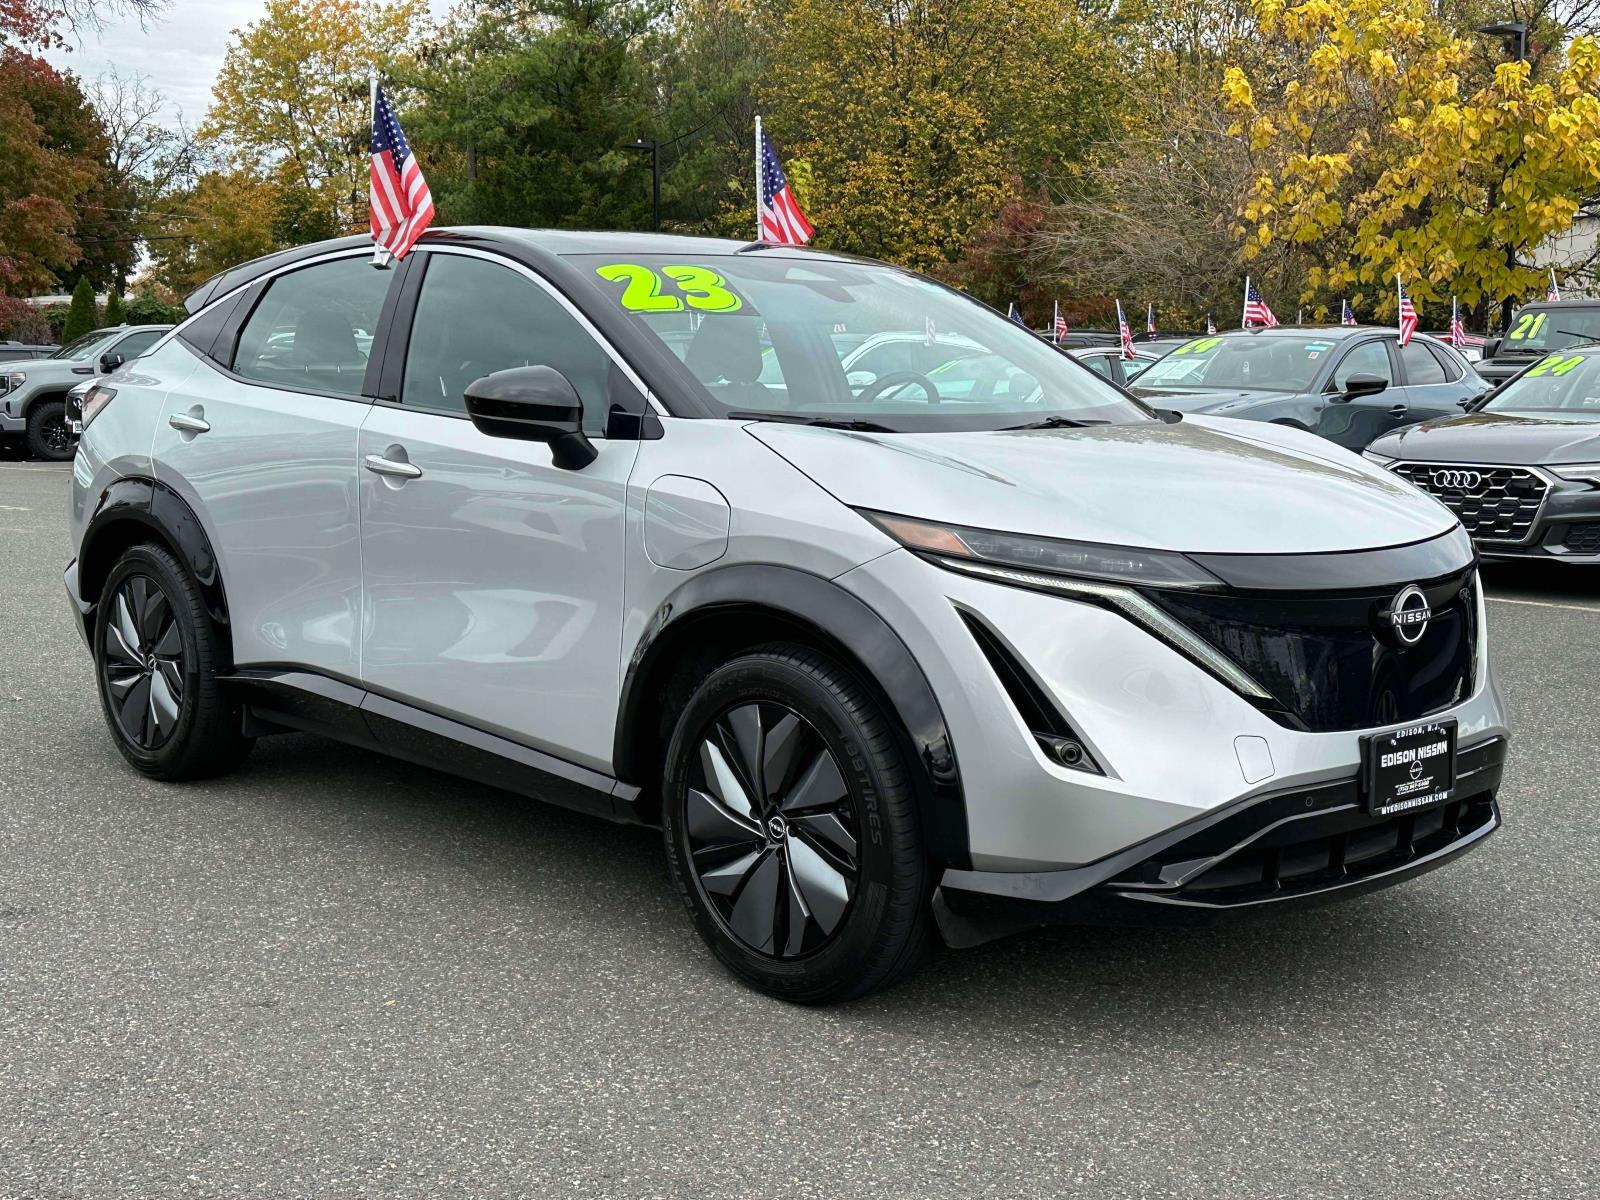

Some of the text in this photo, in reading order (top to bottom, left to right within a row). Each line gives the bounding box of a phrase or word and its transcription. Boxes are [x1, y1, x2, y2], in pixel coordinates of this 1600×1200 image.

[595, 263, 742, 313] 23
[1510, 312, 1547, 339] 21
[1523, 355, 1585, 378] 24
[1393, 609, 1431, 624] NISSAN
[1396, 725, 1425, 739] EDISON,
[1381, 740, 1448, 768] EDISON NISSAN
[1381, 791, 1448, 815] MYEDISONNISSAN.COM
